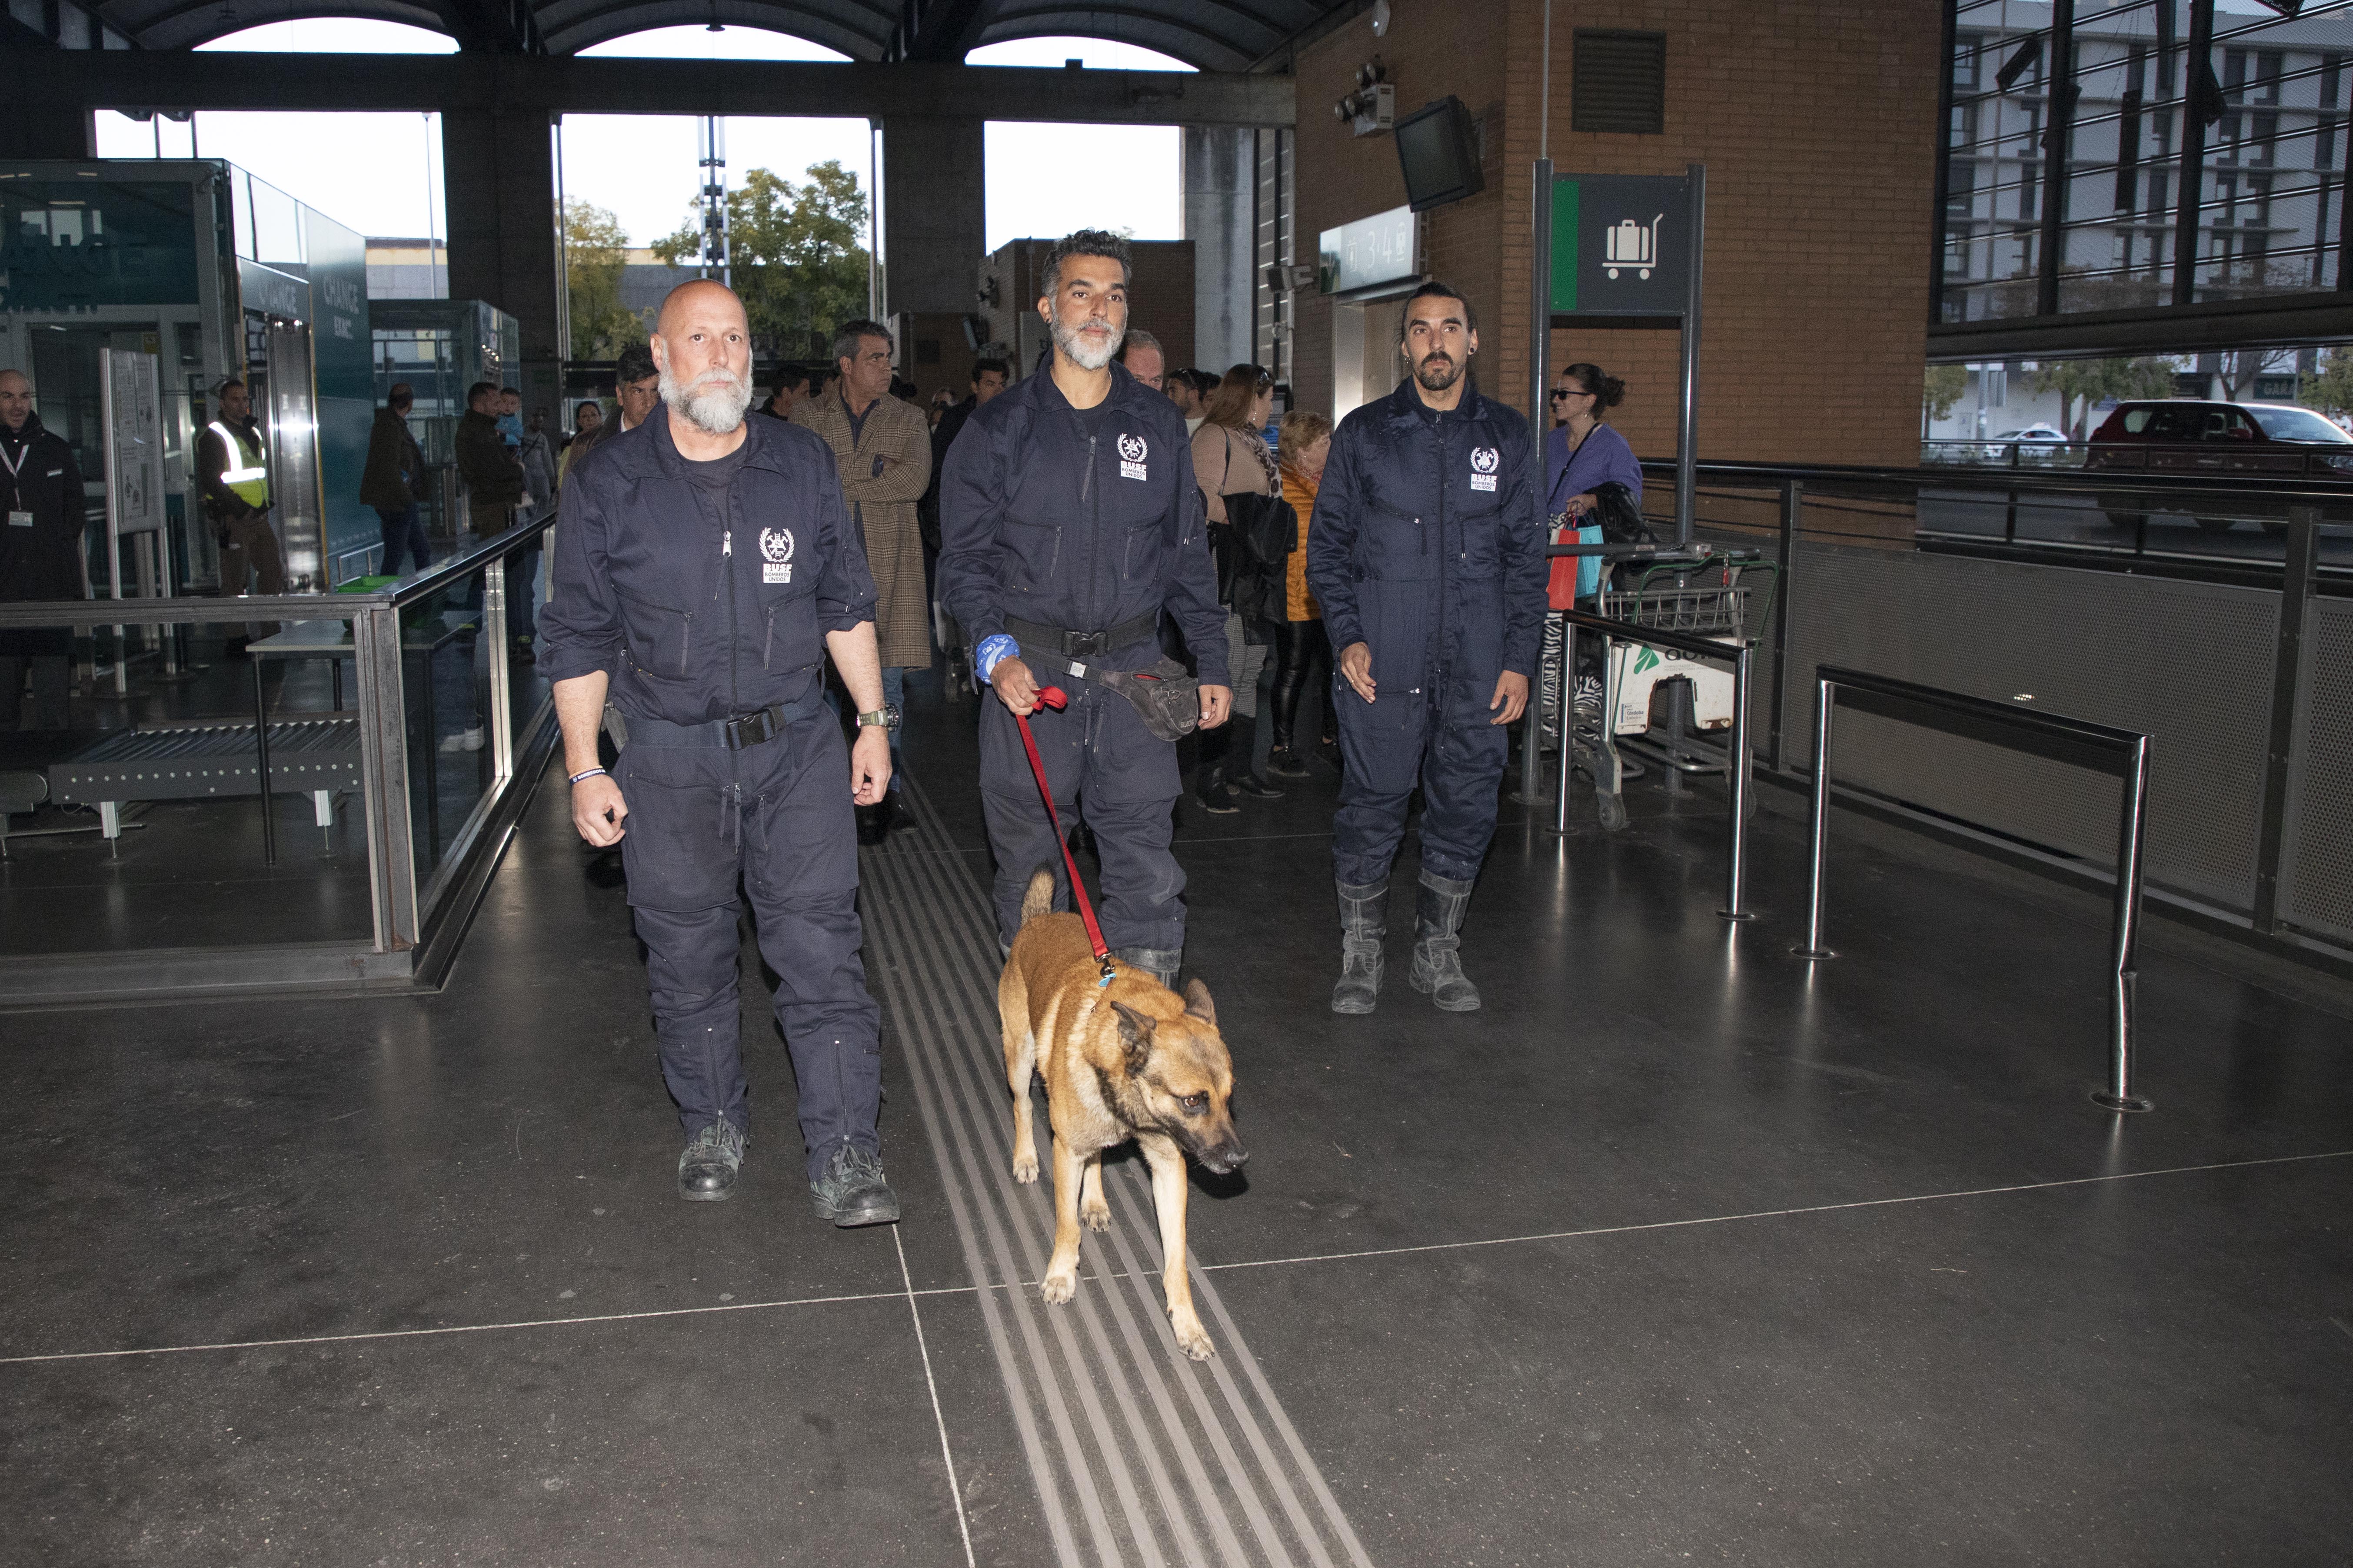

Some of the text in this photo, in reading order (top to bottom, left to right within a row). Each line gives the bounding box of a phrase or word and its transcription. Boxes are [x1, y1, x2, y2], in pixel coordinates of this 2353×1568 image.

[1121, 460, 1147, 471] BUSF
[1471, 473, 1498, 482] BUSF
[763, 563, 792, 572] BUSF
[577, 769, 602, 780] BOMBEROS
